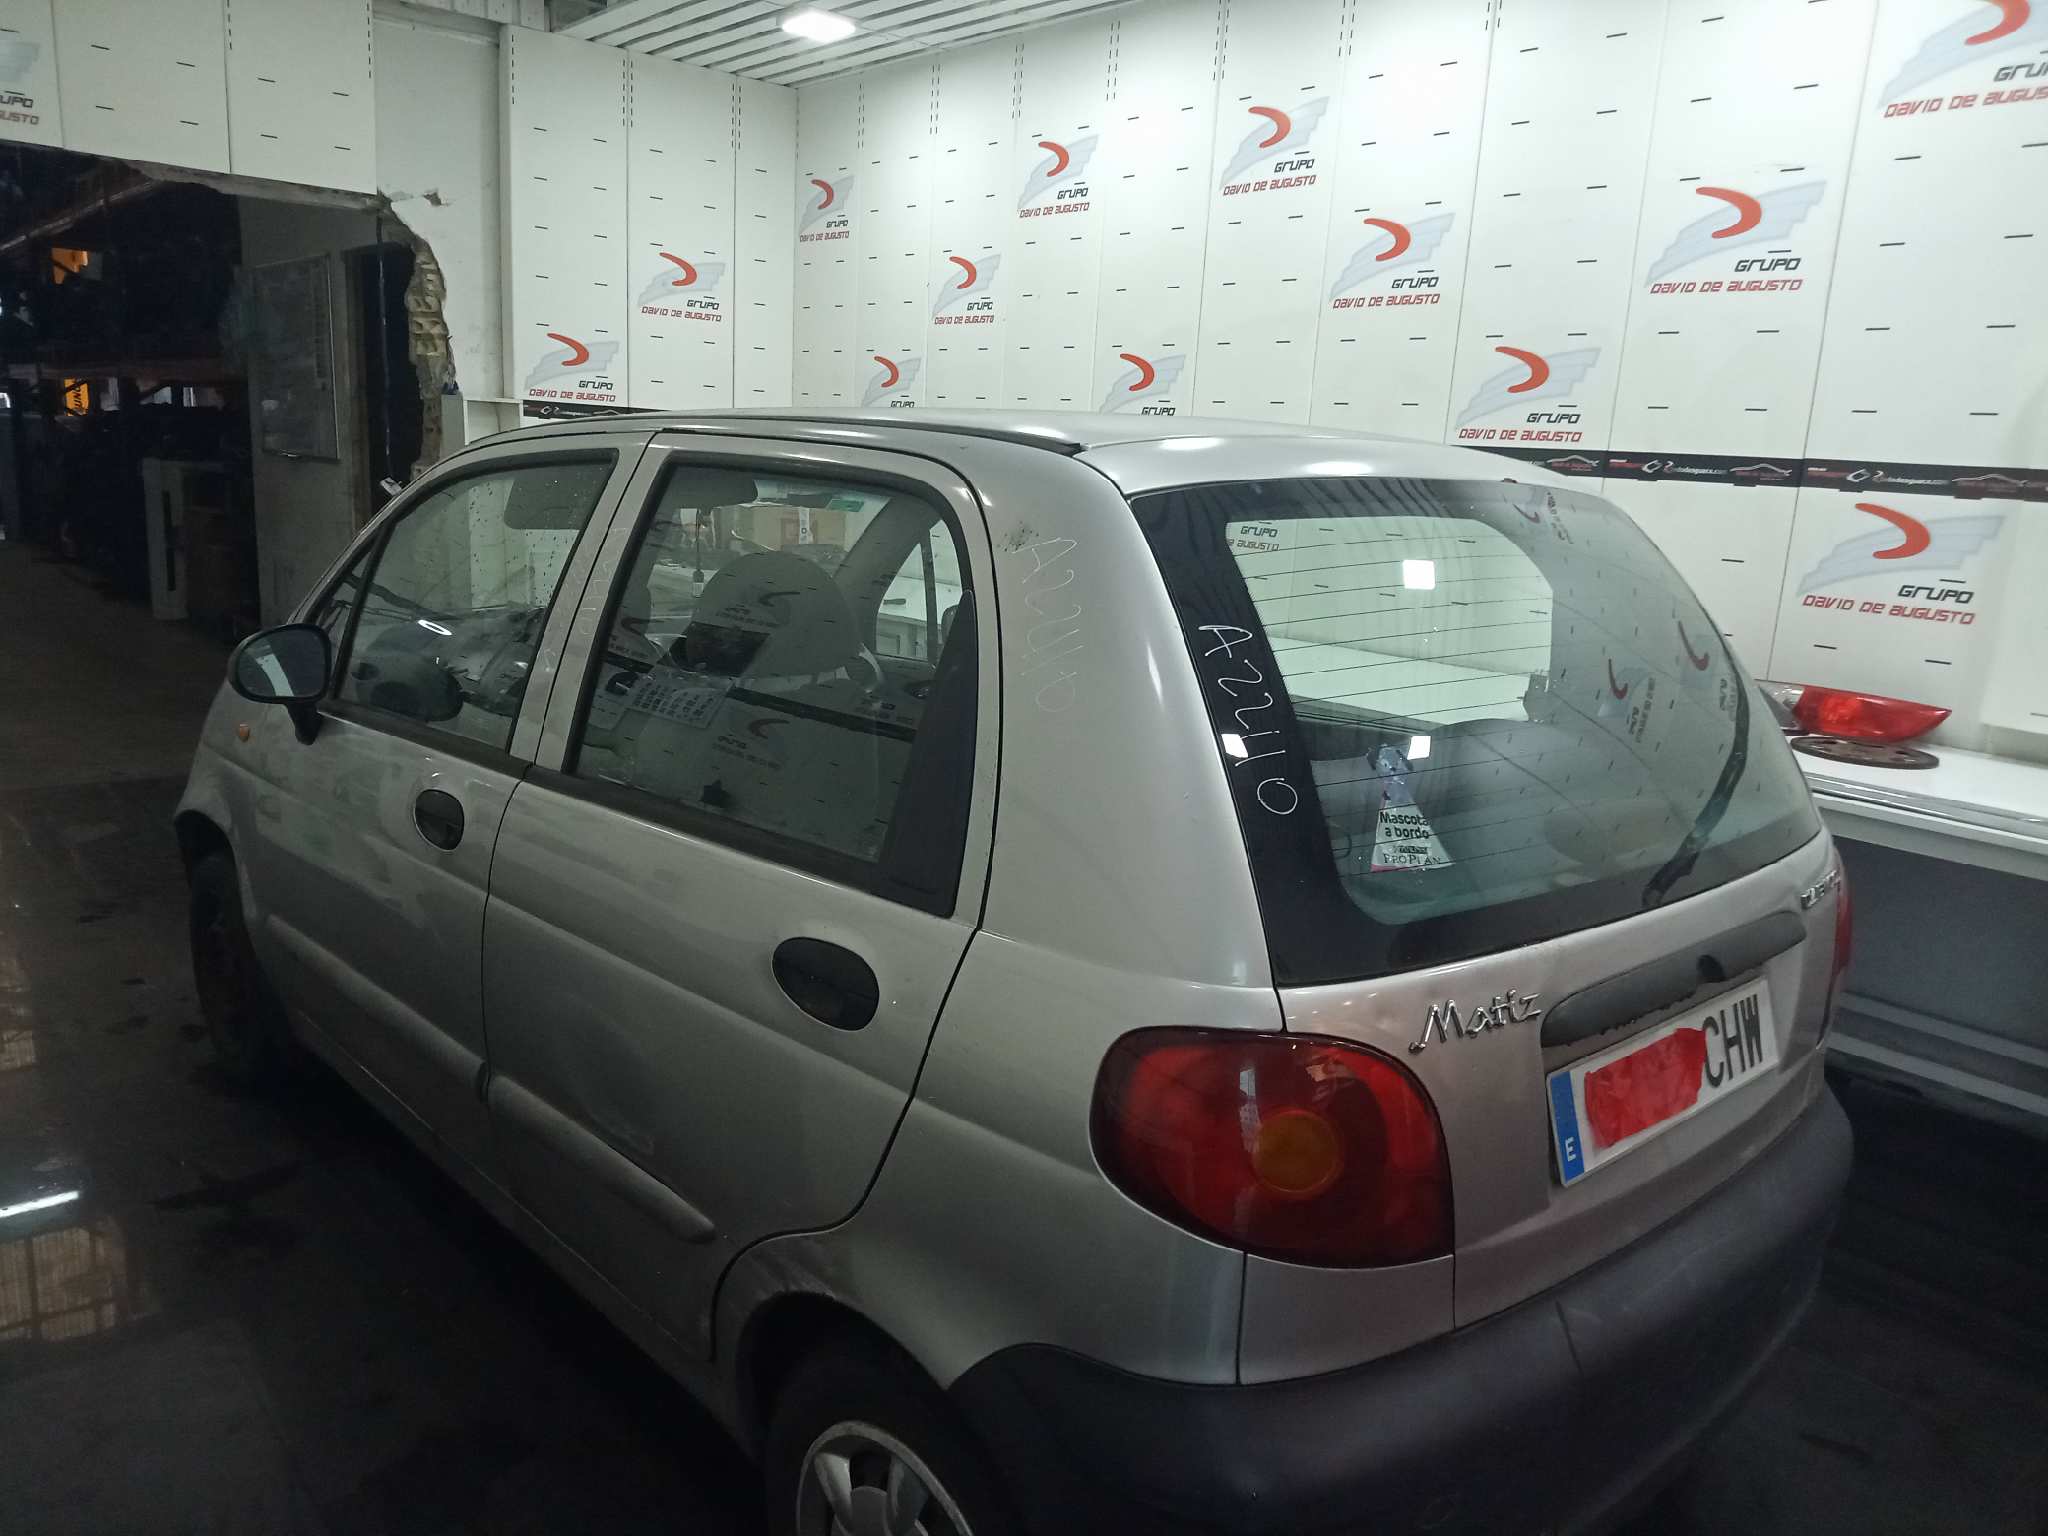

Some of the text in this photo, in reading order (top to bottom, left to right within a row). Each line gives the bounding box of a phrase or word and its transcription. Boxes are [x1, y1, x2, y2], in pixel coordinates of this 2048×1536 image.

[1883, 97, 1944, 118] DAVID
[1947, 93, 1979, 110] DE
[1274, 158, 1315, 173] GRUPO
[1223, 174, 1317, 196] DAVID DE AUGUSTO
[1733, 257, 1802, 273] GRUPO
[1391, 276, 1439, 289] GRUPO
[1649, 278, 1804, 294] DAVID DE AUGUSTO
[1332, 293, 1441, 309] DAVID DE AUGUSTO
[1526, 412, 1581, 424] GRUPO
[1458, 428, 1583, 442] DAVID DE AUGUSTO
[1897, 584, 1975, 604] GRUPO
[1802, 594, 1976, 626] DAVID DE AUGUSTO
[1380, 811, 1429, 826] Mascota
[1384, 826, 1429, 839] a bordo
[1408, 988, 1543, 1055] Matiz
[1563, 1136, 1577, 1162] E
